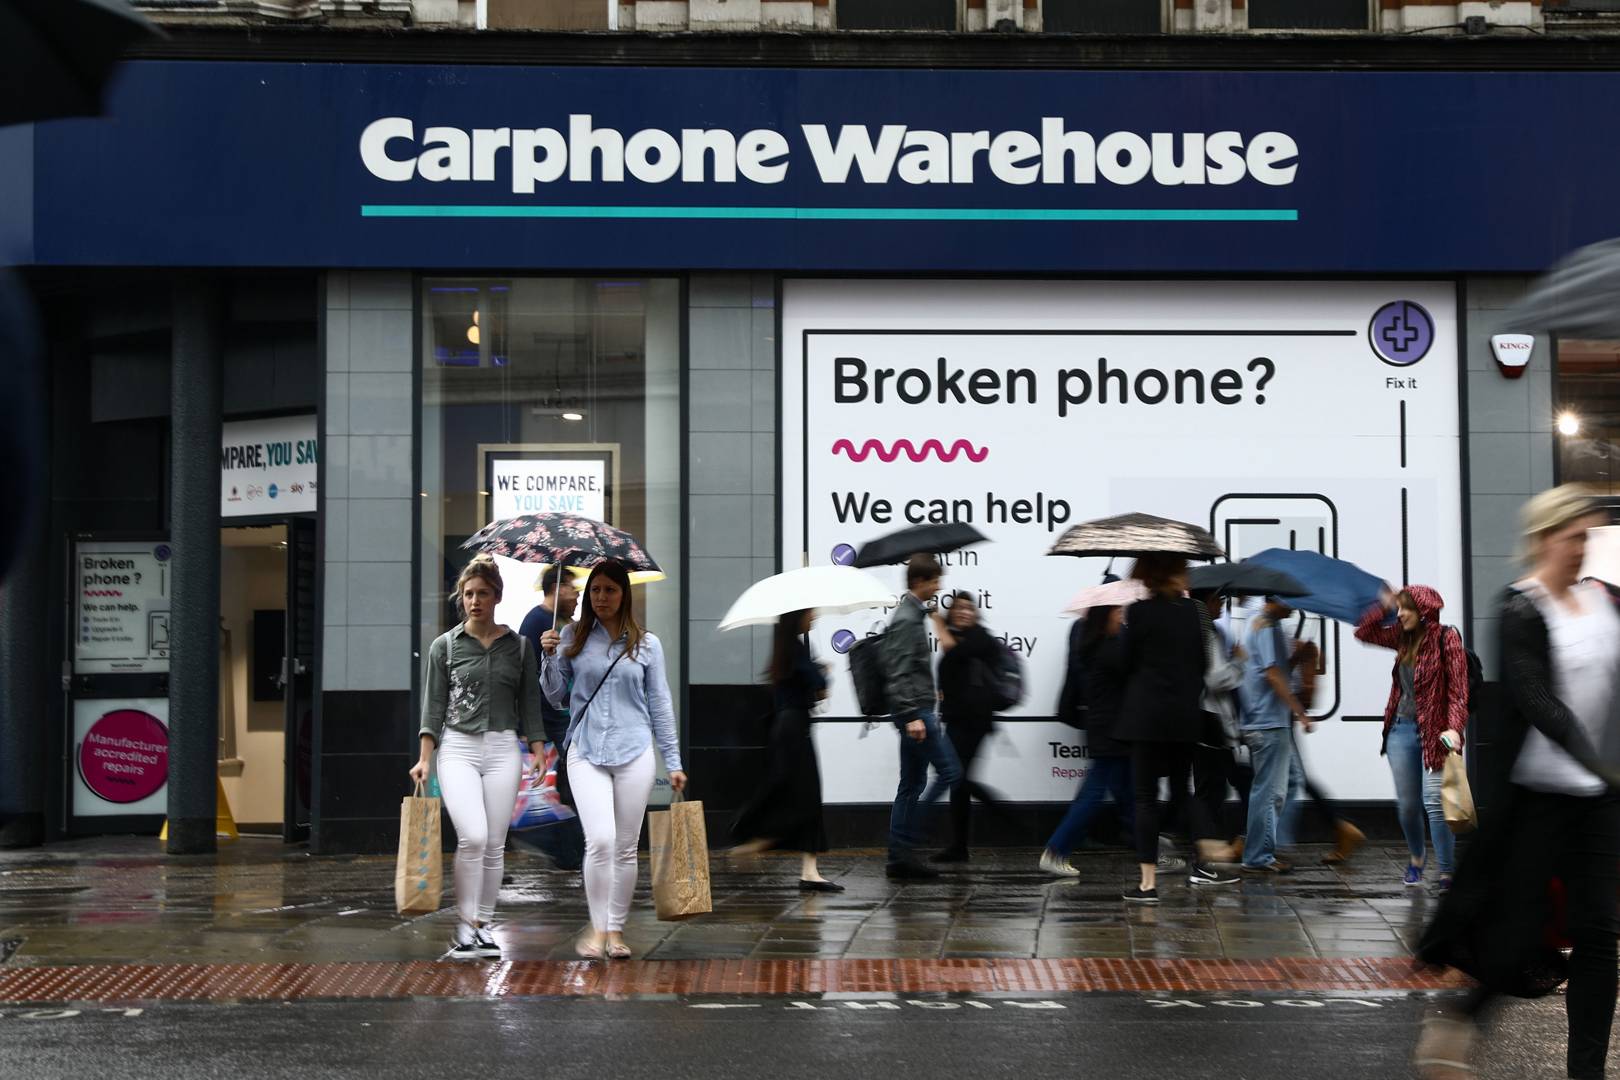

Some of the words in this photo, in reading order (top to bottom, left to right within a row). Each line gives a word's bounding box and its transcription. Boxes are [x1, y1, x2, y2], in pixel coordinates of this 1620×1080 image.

[360, 115, 789, 194] Carphone
[802, 117, 1298, 186] Warehouse
[1499, 342, 1530, 353] KINGS
[834, 357, 1037, 404] Broken
[1057, 357, 1276, 418] phone?
[1386, 378, 1405, 389] Fix
[1408, 378, 1418, 389] it
[266, 441, 292, 467] YOU
[497, 475, 519, 491] WE
[526, 475, 601, 493] COMPARE,
[514, 496, 543, 512] YOU
[548, 496, 585, 512] SAVE
[832, 492, 893, 523] We
[904, 500, 973, 523] can
[986, 491, 1071, 532] help
[83, 557, 136, 570] Broken
[959, 549, 978, 567] in
[83, 572, 131, 588] phone
[978, 588, 993, 609] it
[82, 603, 98, 612] We
[89, 733, 168, 753] Manufacturer
[94, 748, 158, 765] accredited
[103, 762, 144, 775] repairs
